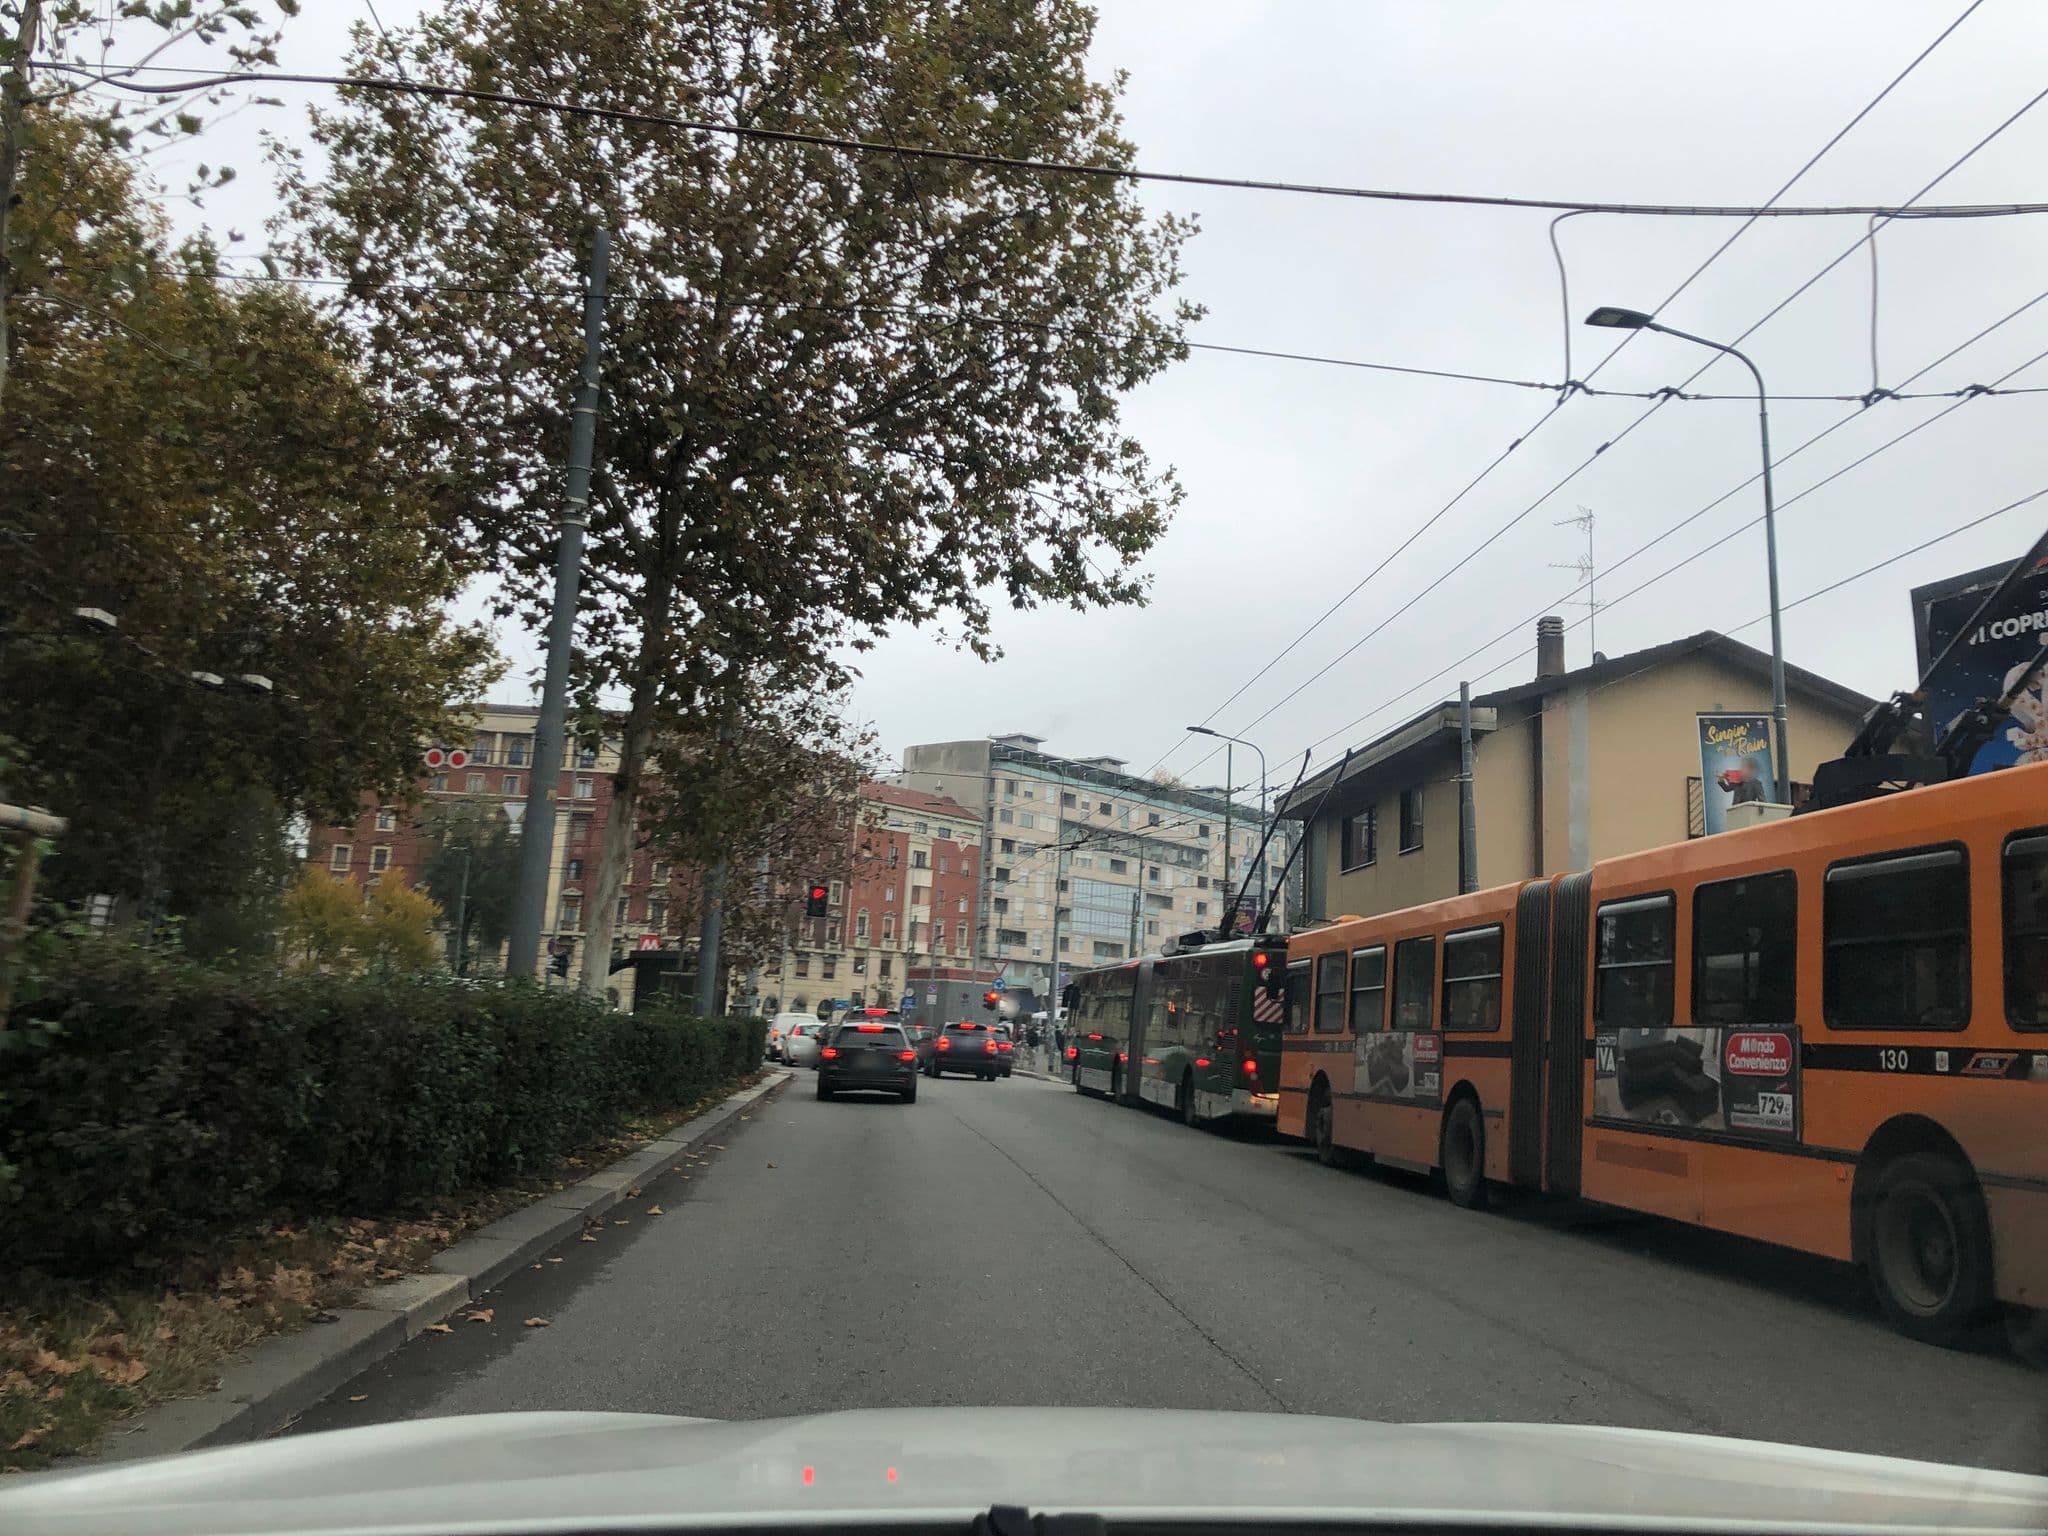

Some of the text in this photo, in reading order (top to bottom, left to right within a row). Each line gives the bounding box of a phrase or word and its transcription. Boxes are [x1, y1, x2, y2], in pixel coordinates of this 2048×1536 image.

[1736, 737, 1767, 757] Rain
[1596, 1047, 1616, 1072] IVA
[1729, 1053, 1787, 1071] Convenienza
[1879, 1049, 1909, 1071] 130
